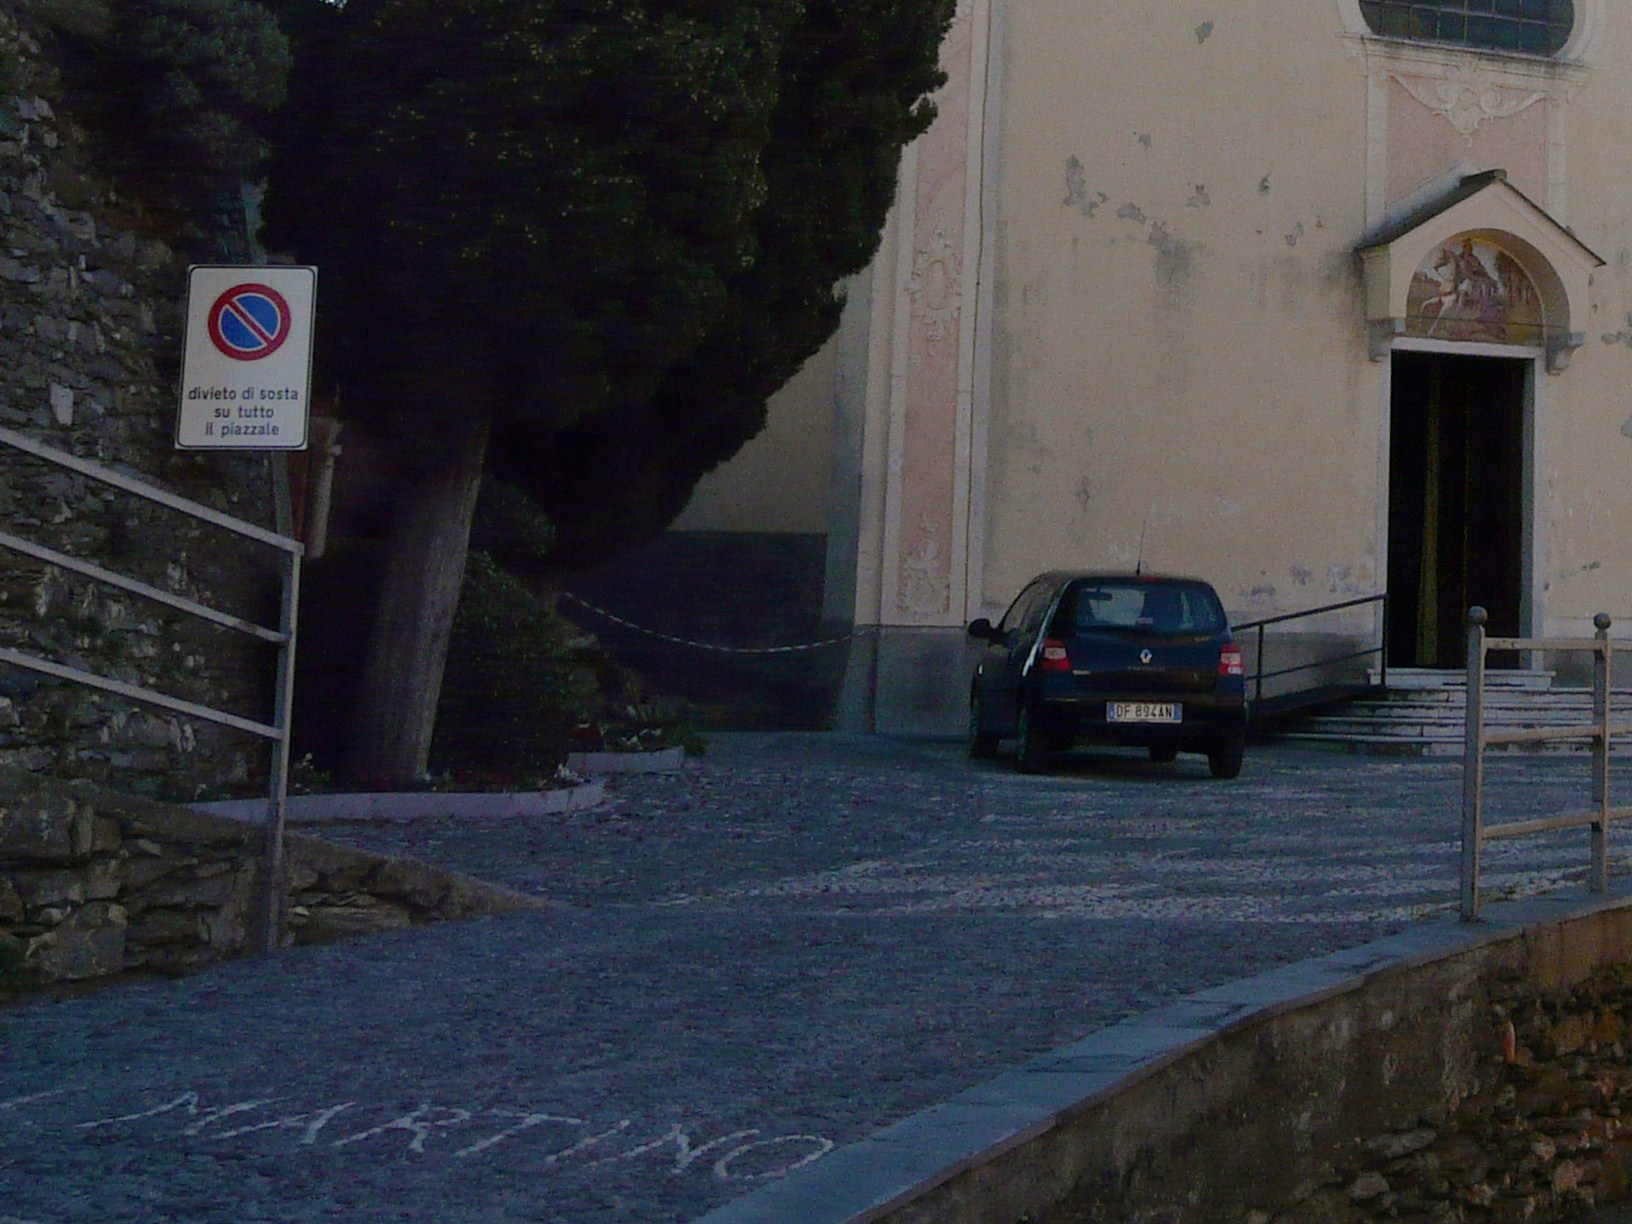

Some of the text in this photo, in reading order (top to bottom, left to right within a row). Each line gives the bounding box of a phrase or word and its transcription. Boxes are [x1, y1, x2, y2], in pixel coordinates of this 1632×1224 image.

[188, 386, 299, 401] divieto di sosta
[214, 405, 275, 419] su tutto
[205, 422, 280, 439] il piazzale
